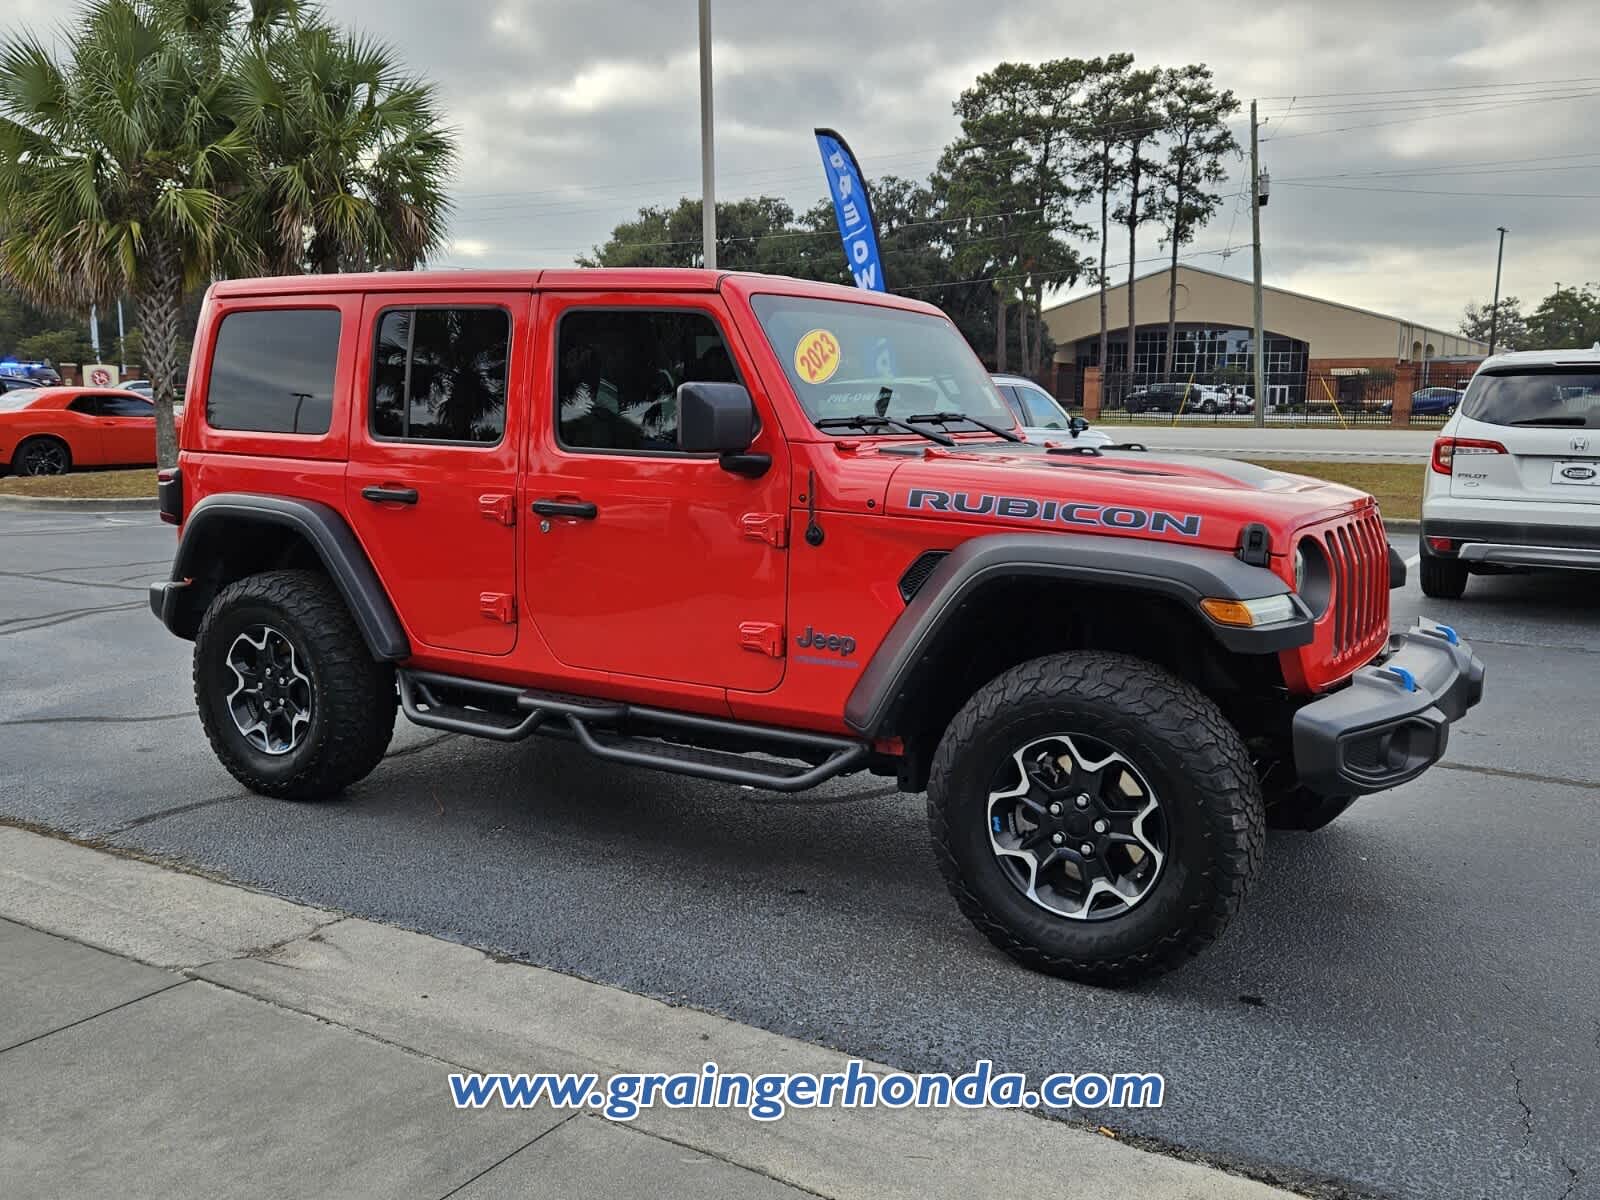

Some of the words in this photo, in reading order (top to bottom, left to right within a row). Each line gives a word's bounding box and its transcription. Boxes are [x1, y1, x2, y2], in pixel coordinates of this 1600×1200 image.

[800, 332, 836, 380] 2023
[907, 488, 1201, 536] RUBICON
[796, 625, 857, 656] Jeep
